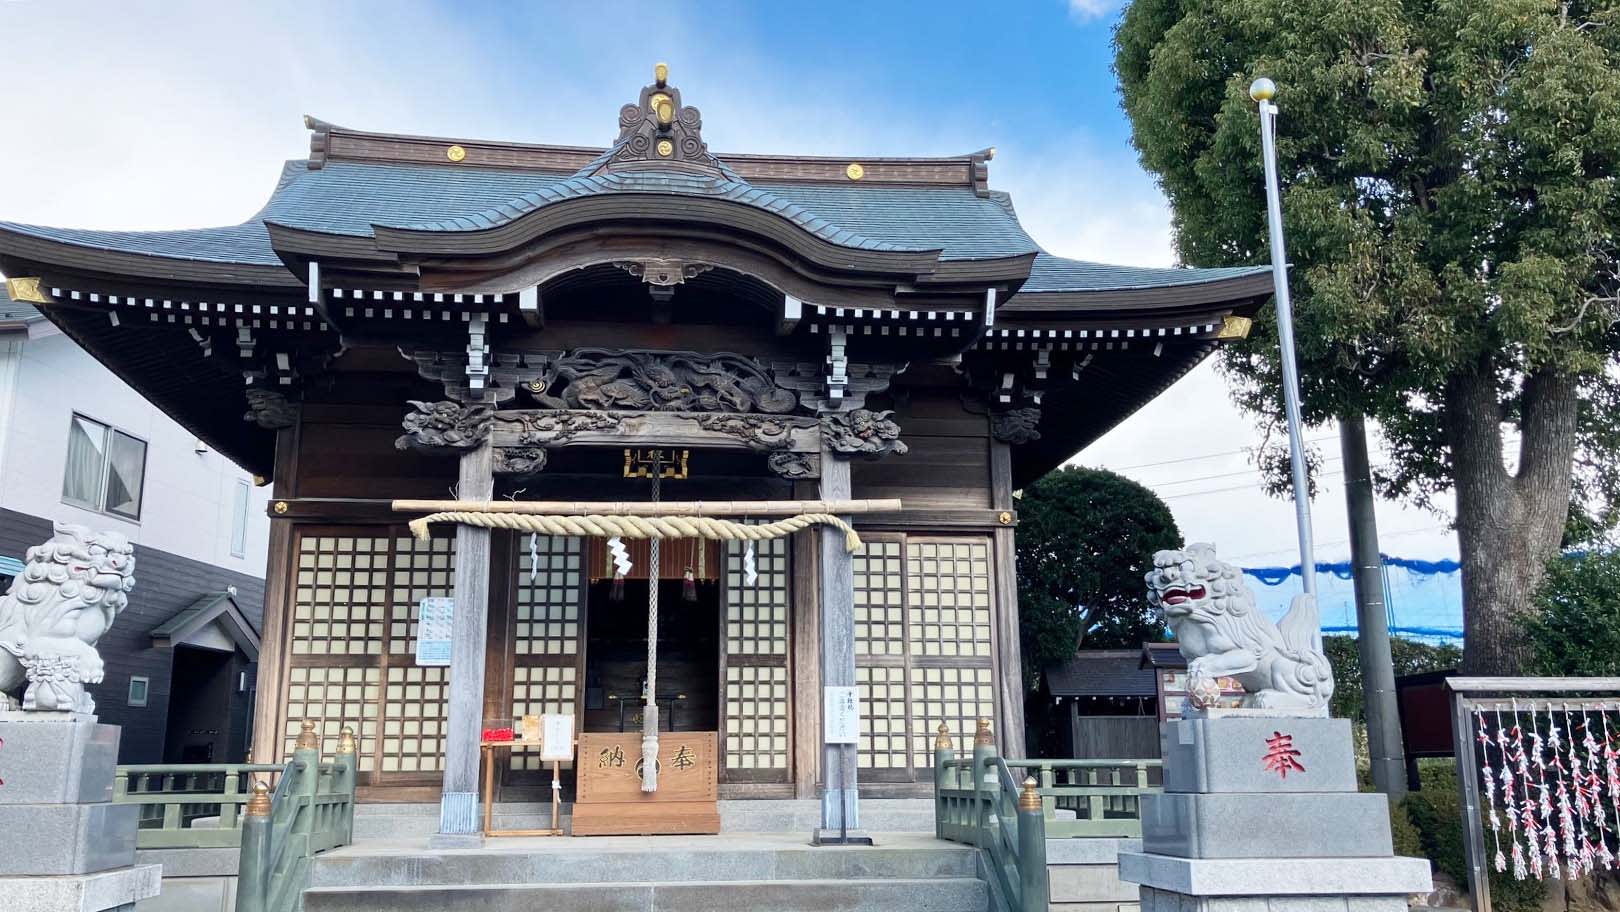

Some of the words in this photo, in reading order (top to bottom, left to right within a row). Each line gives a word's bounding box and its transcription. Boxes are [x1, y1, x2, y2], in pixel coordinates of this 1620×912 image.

[599, 745, 625, 768] 納
[672, 745, 697, 771] 奉
[1262, 731, 1306, 779] 奉
